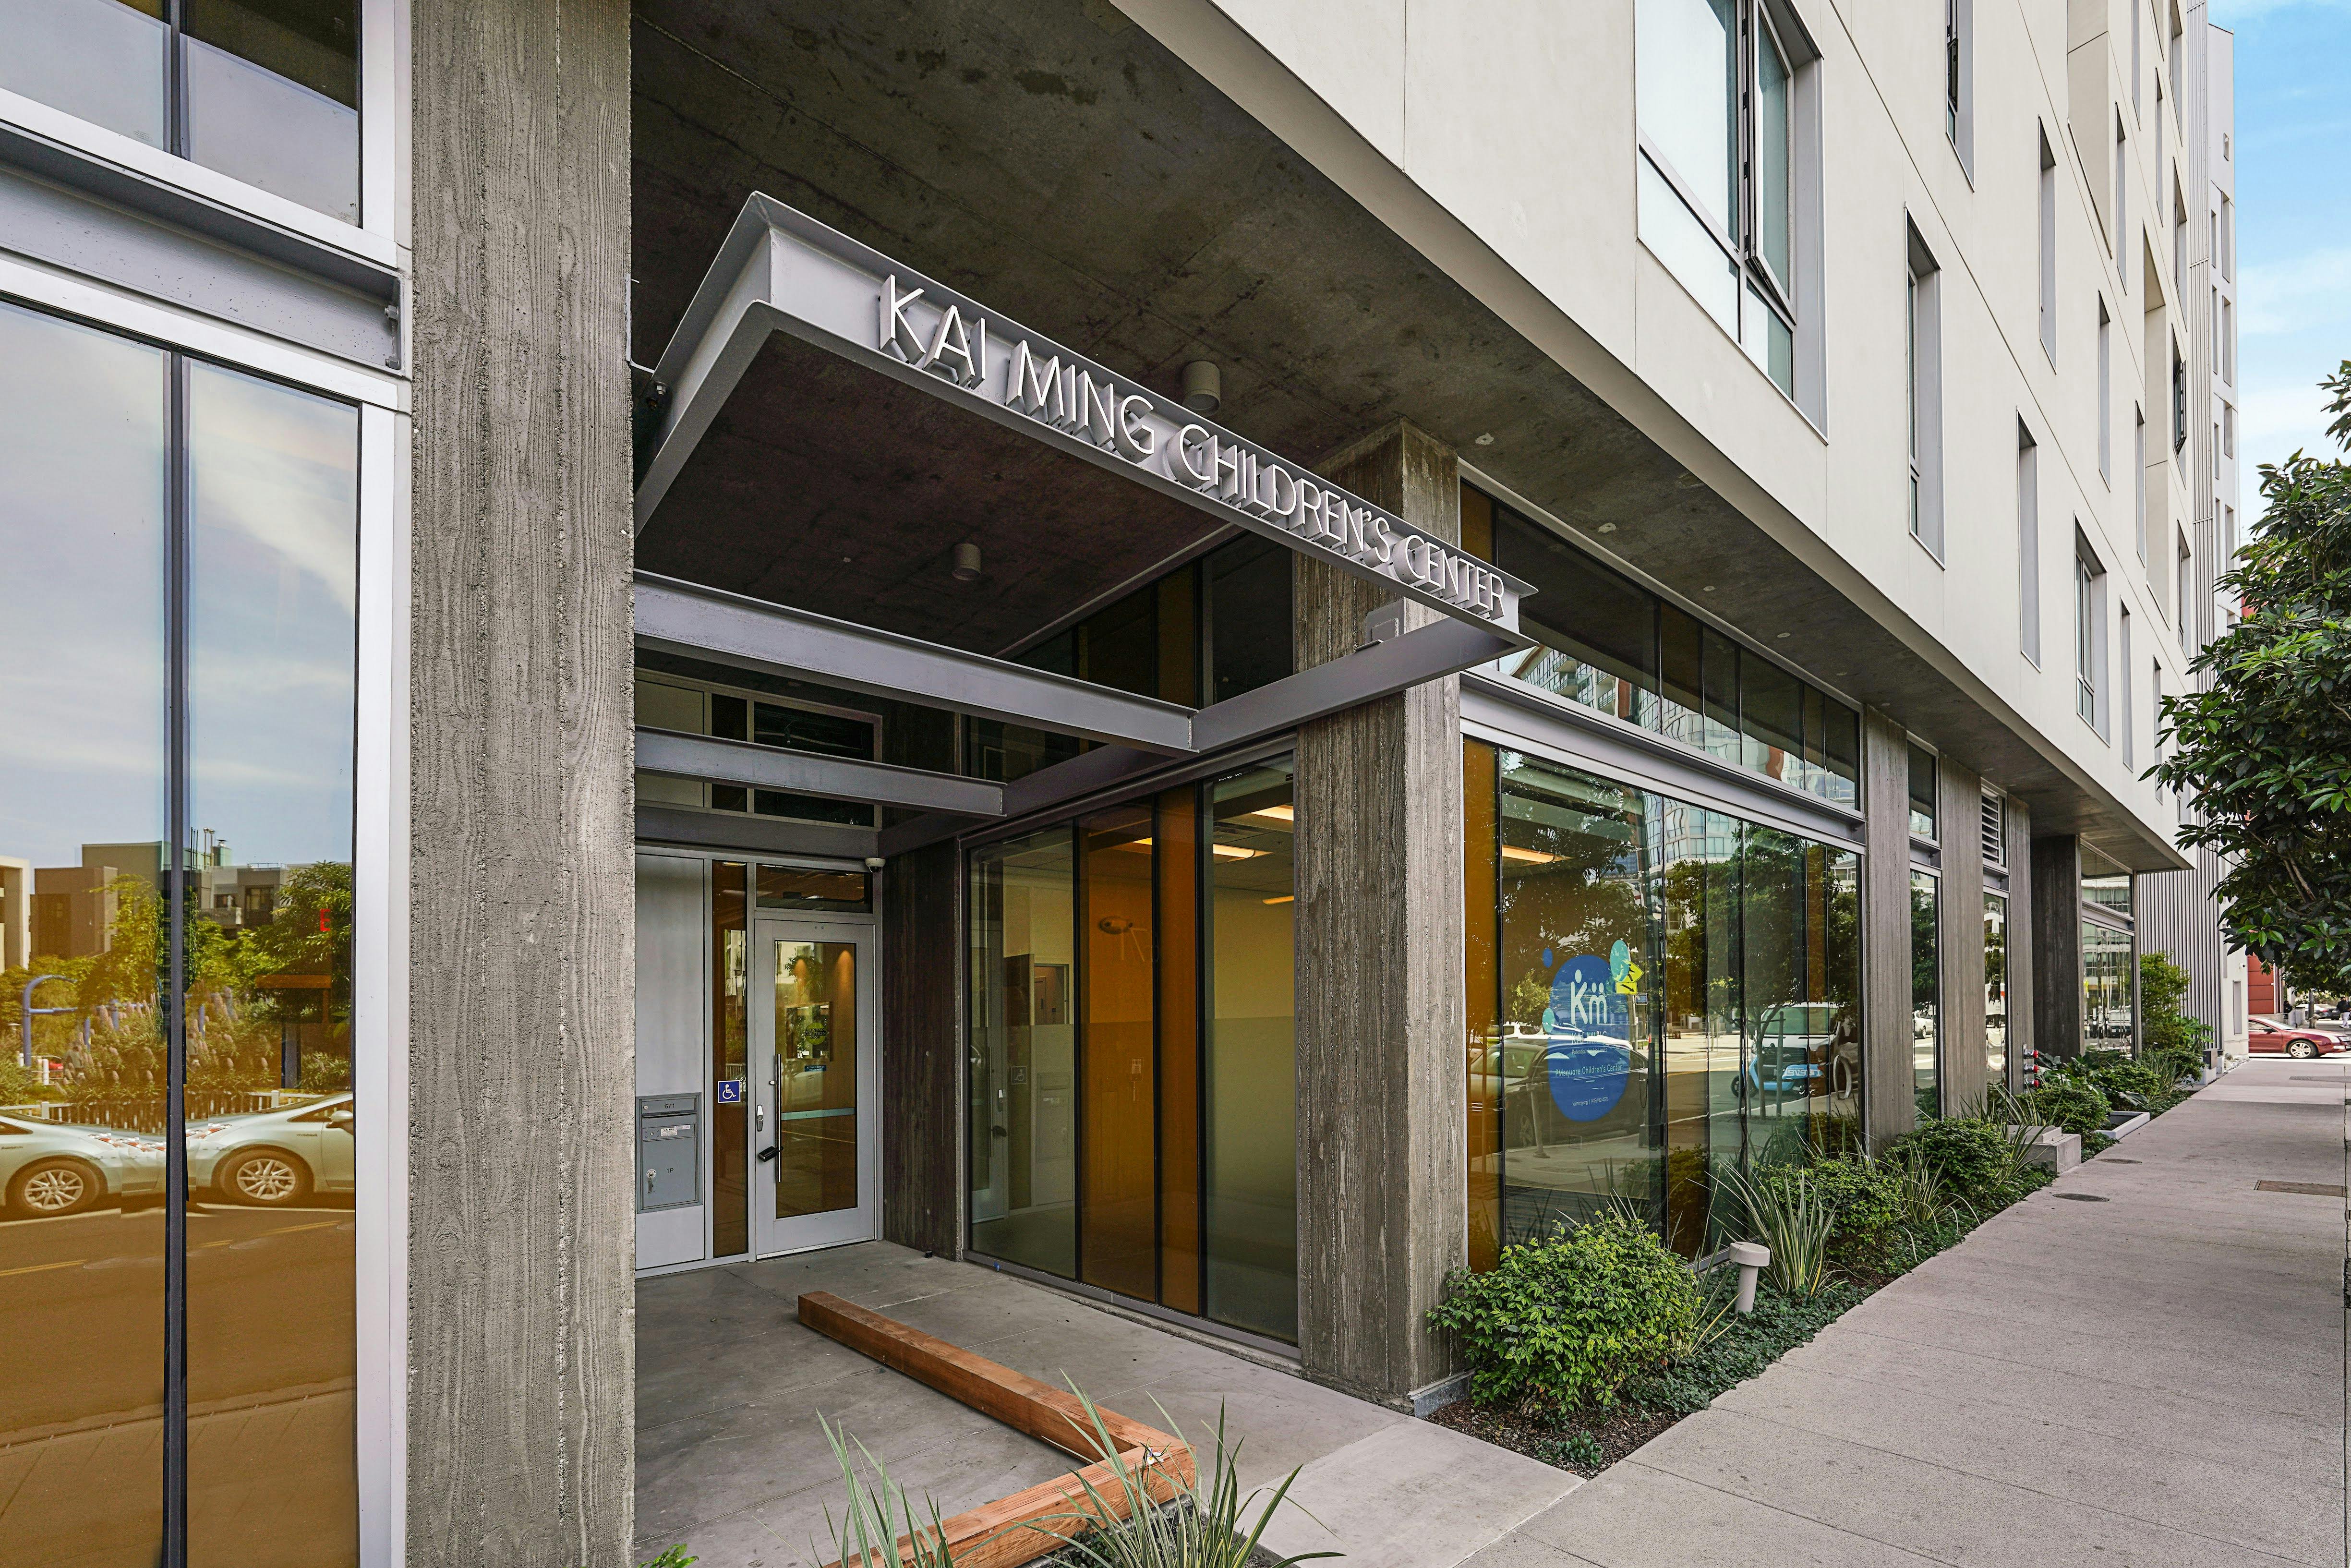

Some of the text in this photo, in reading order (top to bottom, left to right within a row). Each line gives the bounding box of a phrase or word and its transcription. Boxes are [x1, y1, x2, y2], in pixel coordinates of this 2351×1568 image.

[883, 274, 1507, 619] KAI MING CHILDREN'S CENTER
[1555, 1069, 1580, 1077] PMsquare
[1582, 1065, 1606, 1074] Children's
